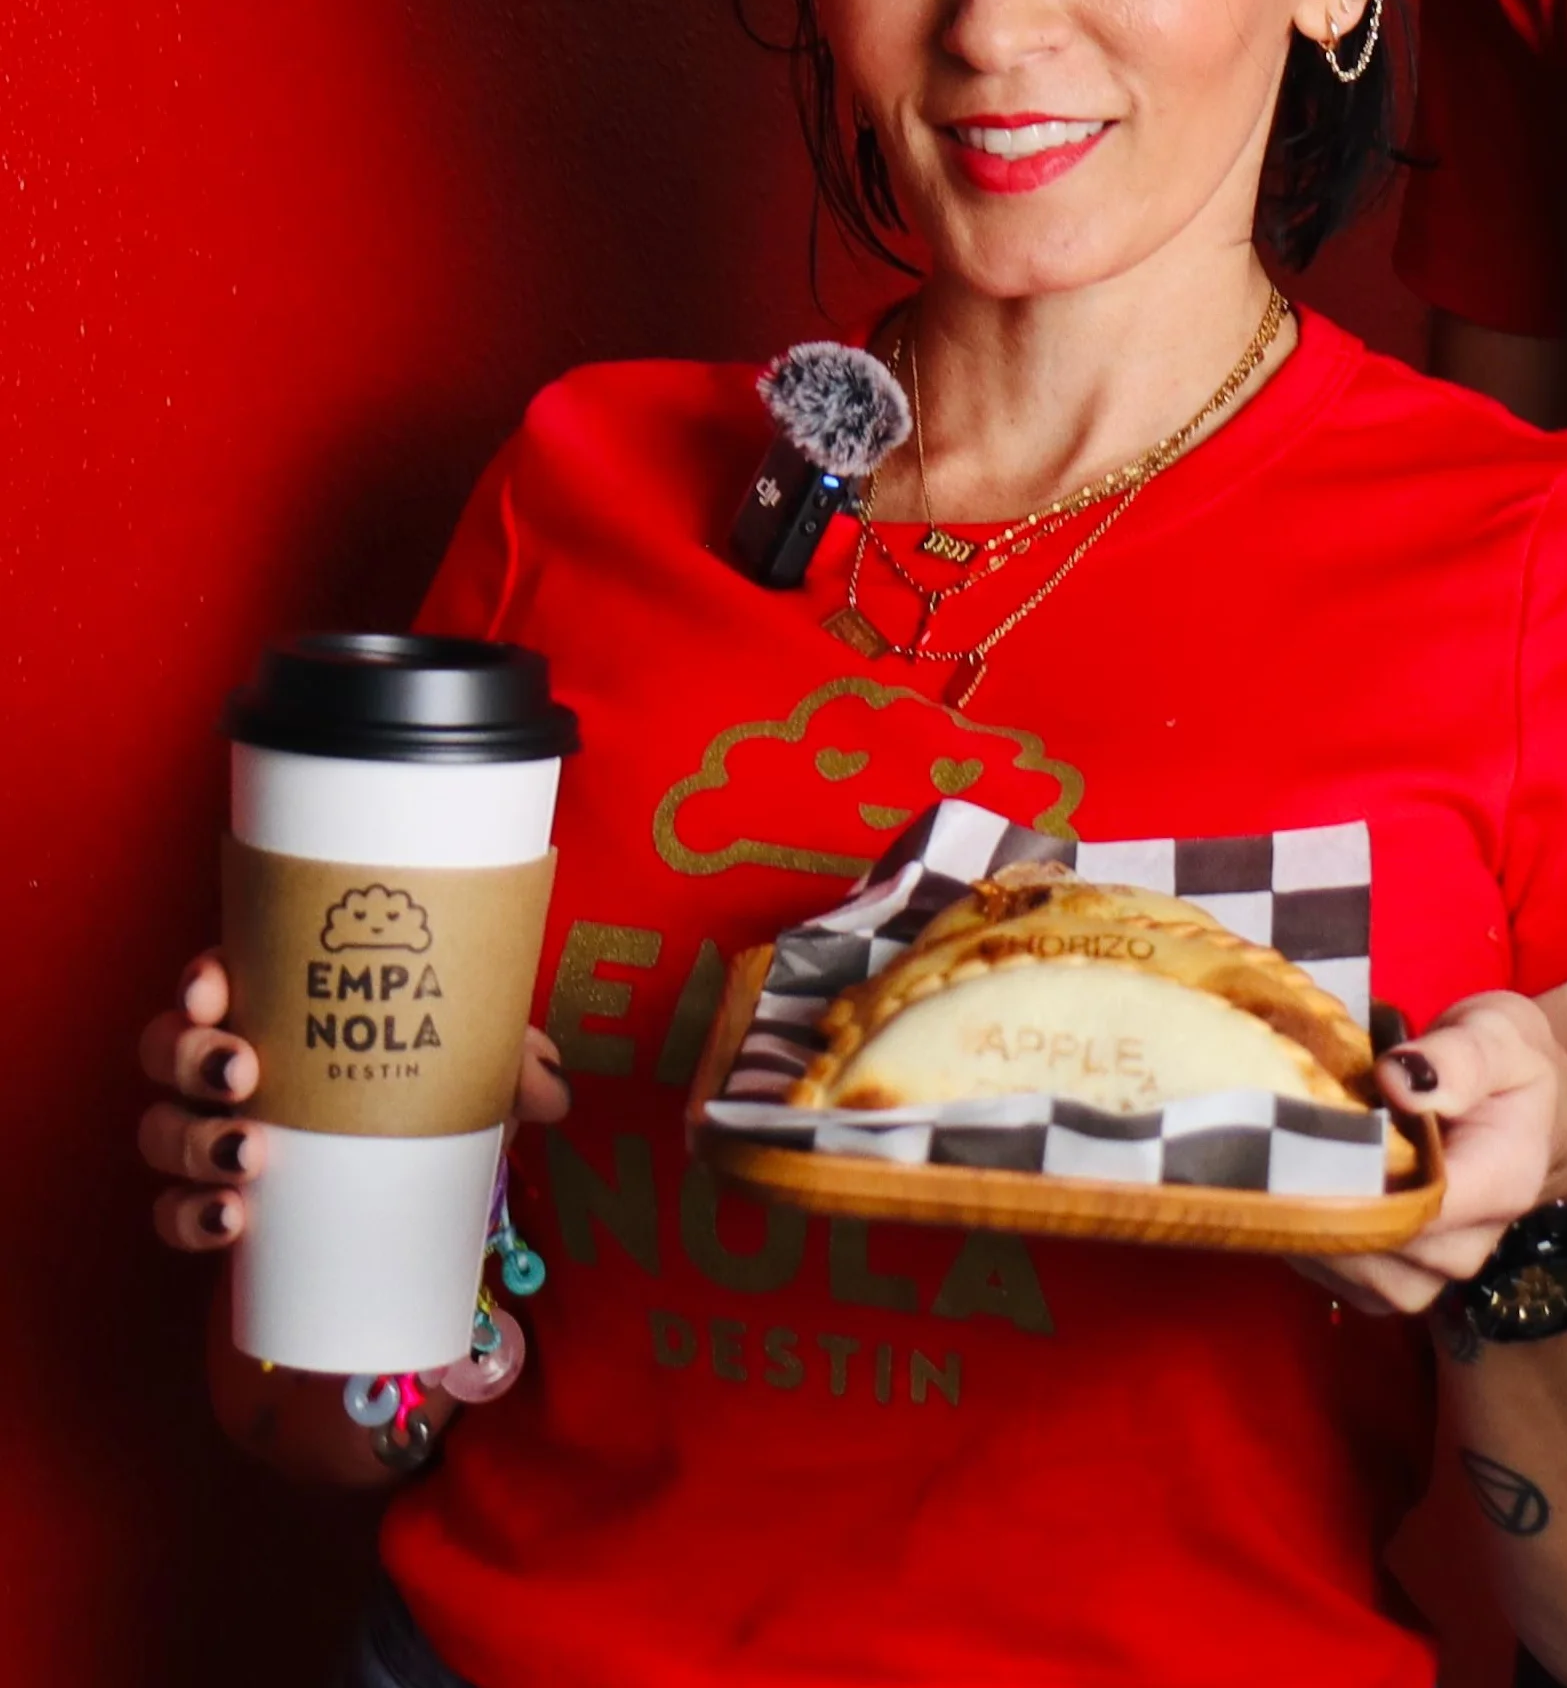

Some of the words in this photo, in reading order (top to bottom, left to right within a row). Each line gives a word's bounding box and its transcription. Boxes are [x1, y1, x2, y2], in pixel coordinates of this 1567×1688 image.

[306, 961, 443, 1001] EMPA
[305, 1011, 442, 1052] NOLA
[975, 1021, 1146, 1078] APPLE
[328, 1063, 420, 1080] DESTIN
[648, 1309, 963, 1407] DESTIN
